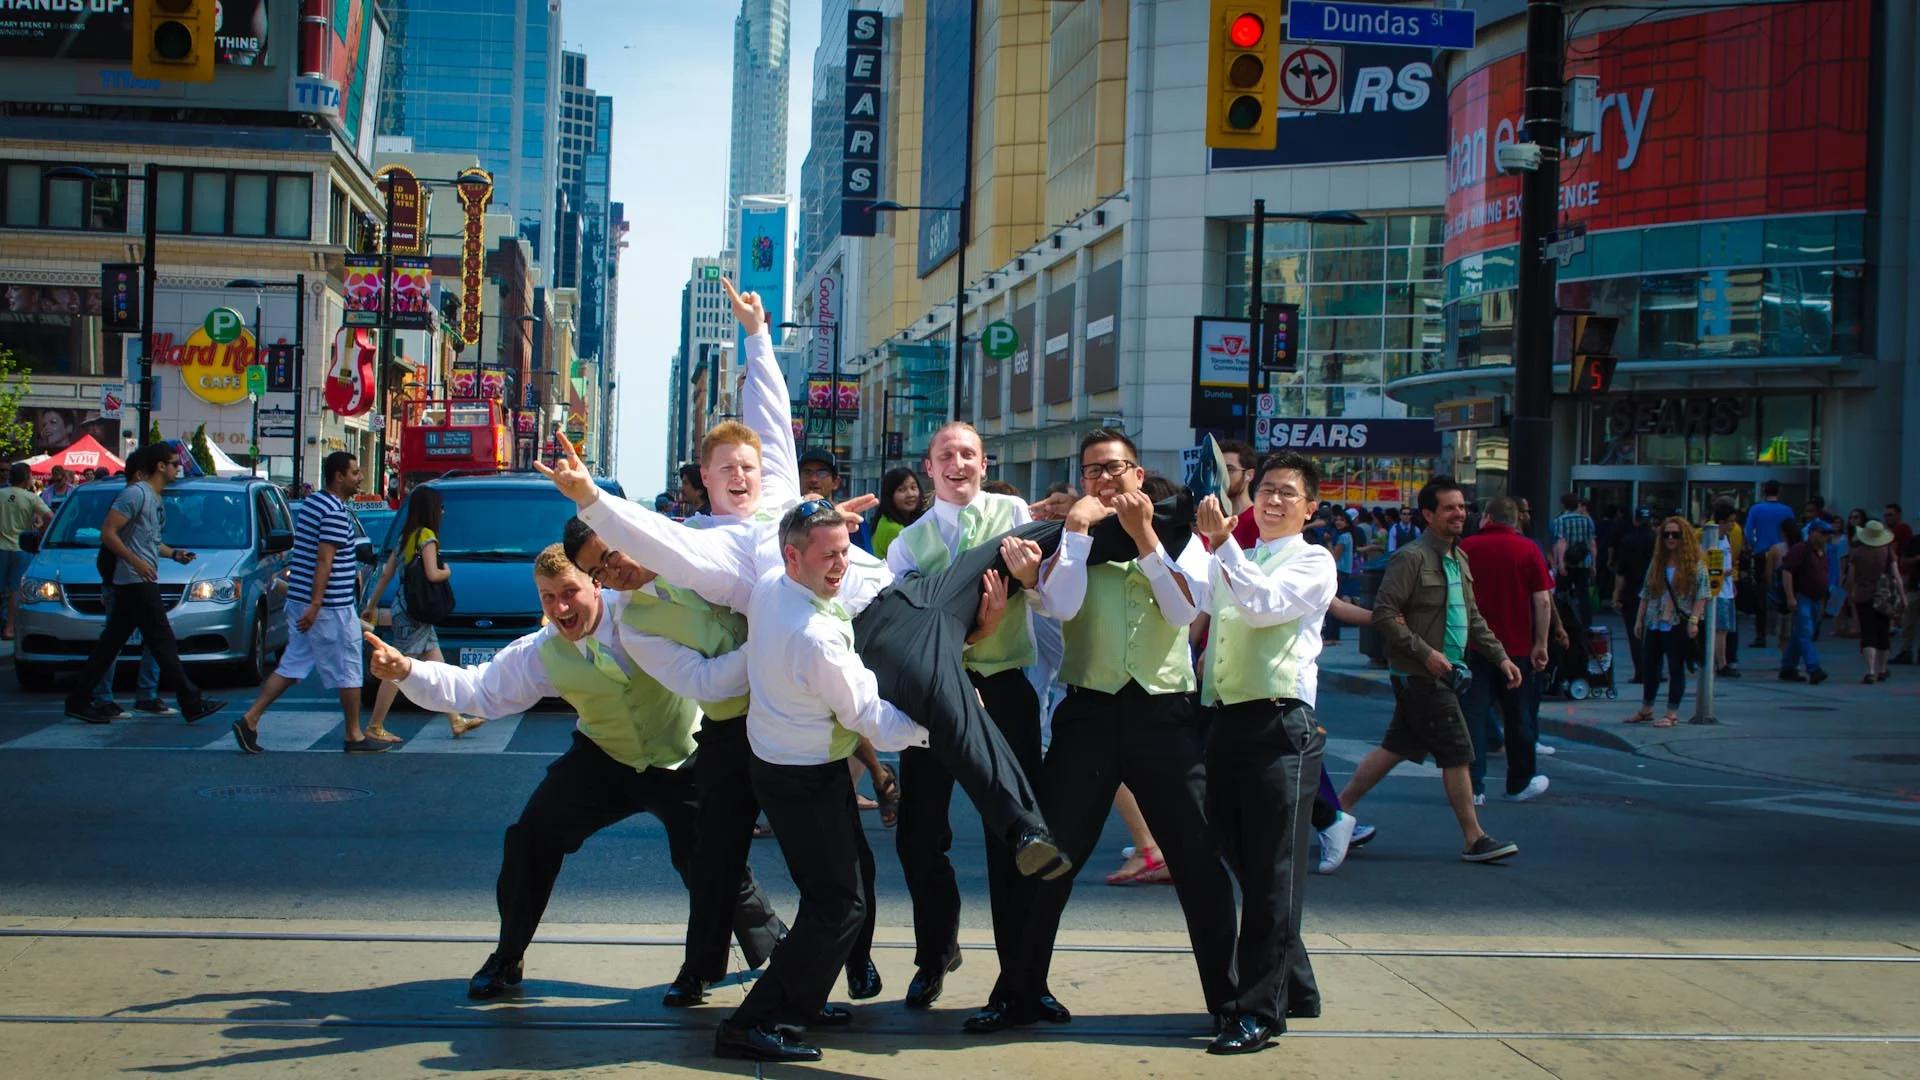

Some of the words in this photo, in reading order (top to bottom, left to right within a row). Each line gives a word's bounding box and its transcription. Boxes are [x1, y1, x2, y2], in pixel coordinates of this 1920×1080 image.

[1323, 6, 1420, 36] Dundas
[1431, 12, 1444, 27] St
[214, 36, 258, 49] THING
[849, 16, 877, 192] SEARS
[213, 311, 237, 336] P
[150, 332, 217, 367] Hard
[990, 326, 1014, 350] P
[199, 374, 242, 390] CAFE
[1590, 361, 1602, 390] 5
[1204, 390, 1233, 399] Dundas
[1271, 423, 1368, 448] SEARS
[66, 454, 98, 465] NOW
